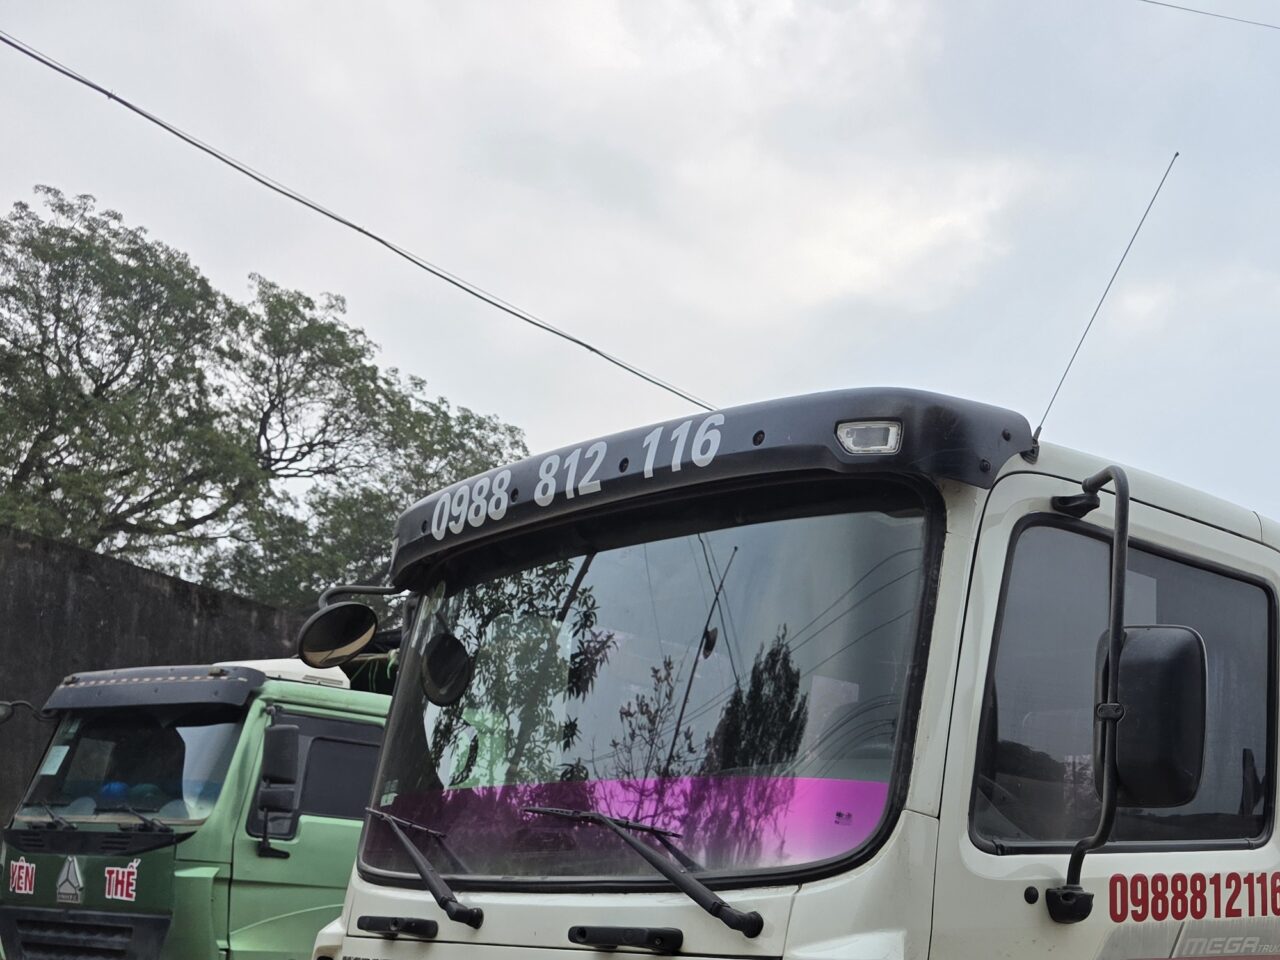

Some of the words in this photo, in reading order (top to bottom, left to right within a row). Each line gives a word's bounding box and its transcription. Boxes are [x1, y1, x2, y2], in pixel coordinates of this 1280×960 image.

[431, 469, 512, 541] 0988
[534, 440, 607, 507] 812
[642, 413, 725, 478] 116
[10, 856, 36, 894] YÊN
[105, 858, 141, 901] THẾ
[1182, 936, 1260, 955] MEGA
